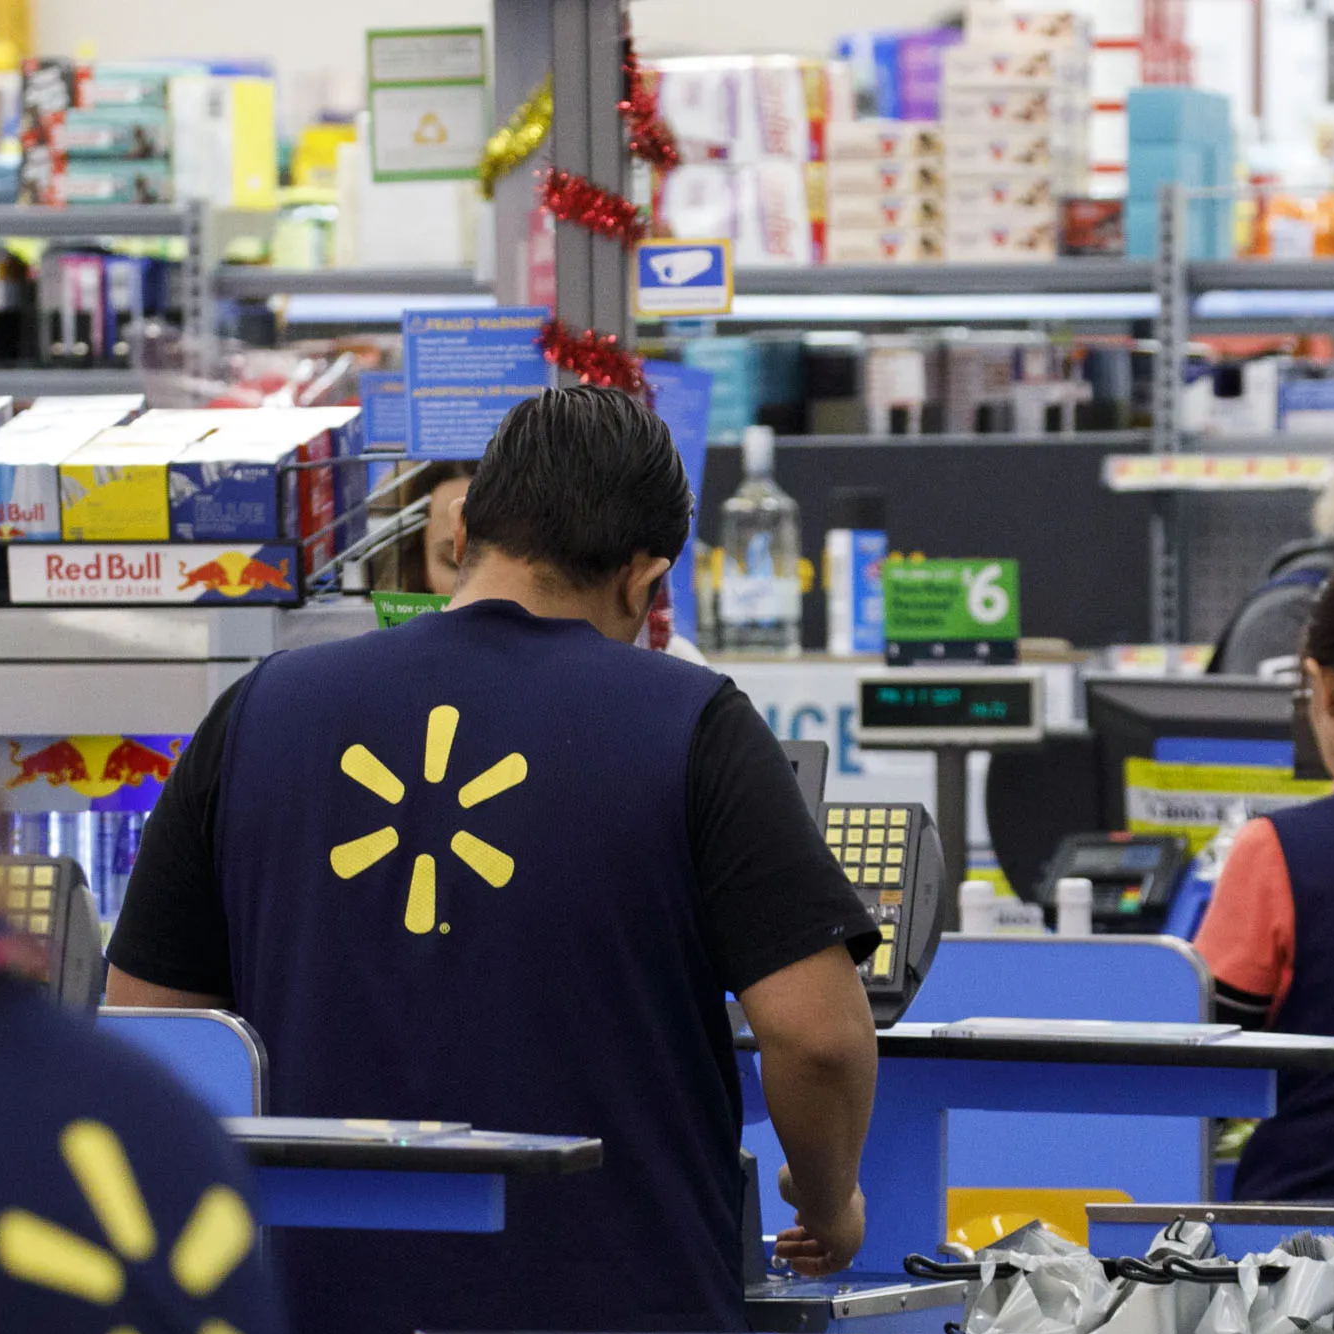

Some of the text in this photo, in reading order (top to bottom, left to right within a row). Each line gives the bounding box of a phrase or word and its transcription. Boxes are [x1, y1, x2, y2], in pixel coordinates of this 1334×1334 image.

[8, 503, 45, 522] Bull
[46, 552, 161, 580] Red Bull
[47, 586, 161, 598] ENERGY DRINK
[380, 601, 395, 613] We
[397, 604, 413, 613] now
